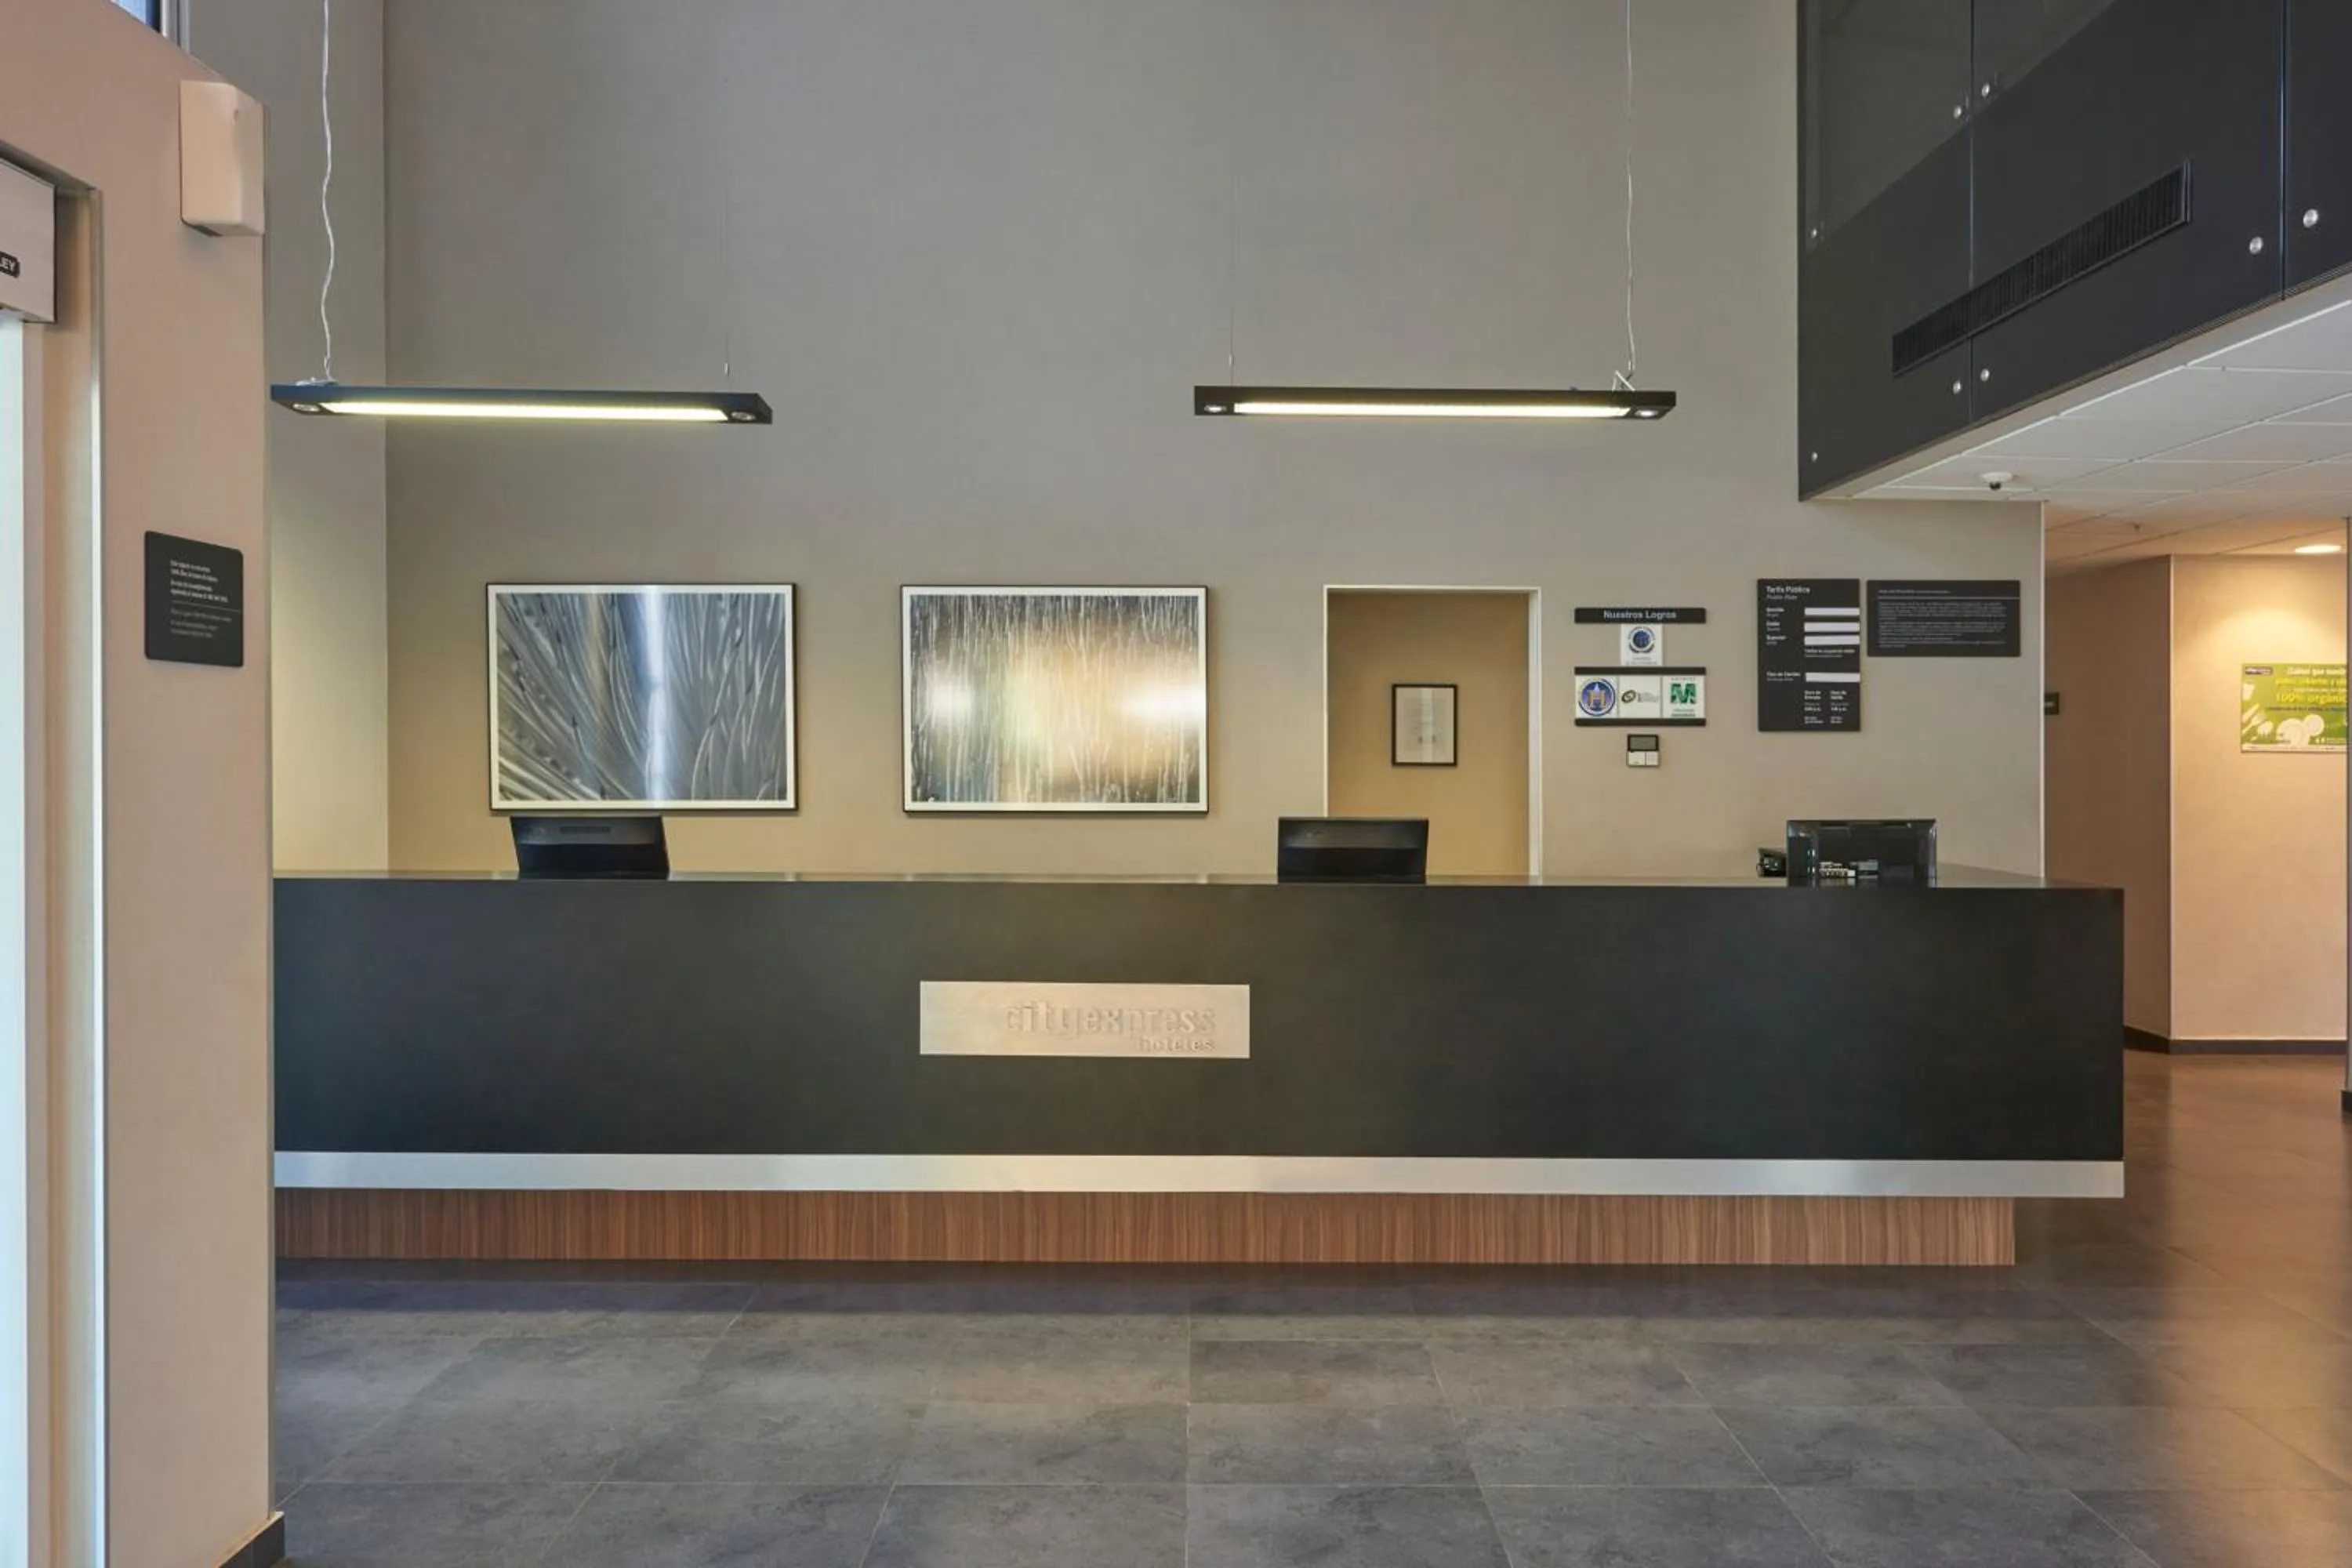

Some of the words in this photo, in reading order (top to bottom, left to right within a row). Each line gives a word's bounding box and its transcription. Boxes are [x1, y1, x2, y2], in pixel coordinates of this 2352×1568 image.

[1603, 610, 1643, 619] Nuestros
[1646, 610, 1677, 620] Logros
[1007, 1000, 1217, 1039] cityexpress
[1137, 1035, 1218, 1053] hoteles
